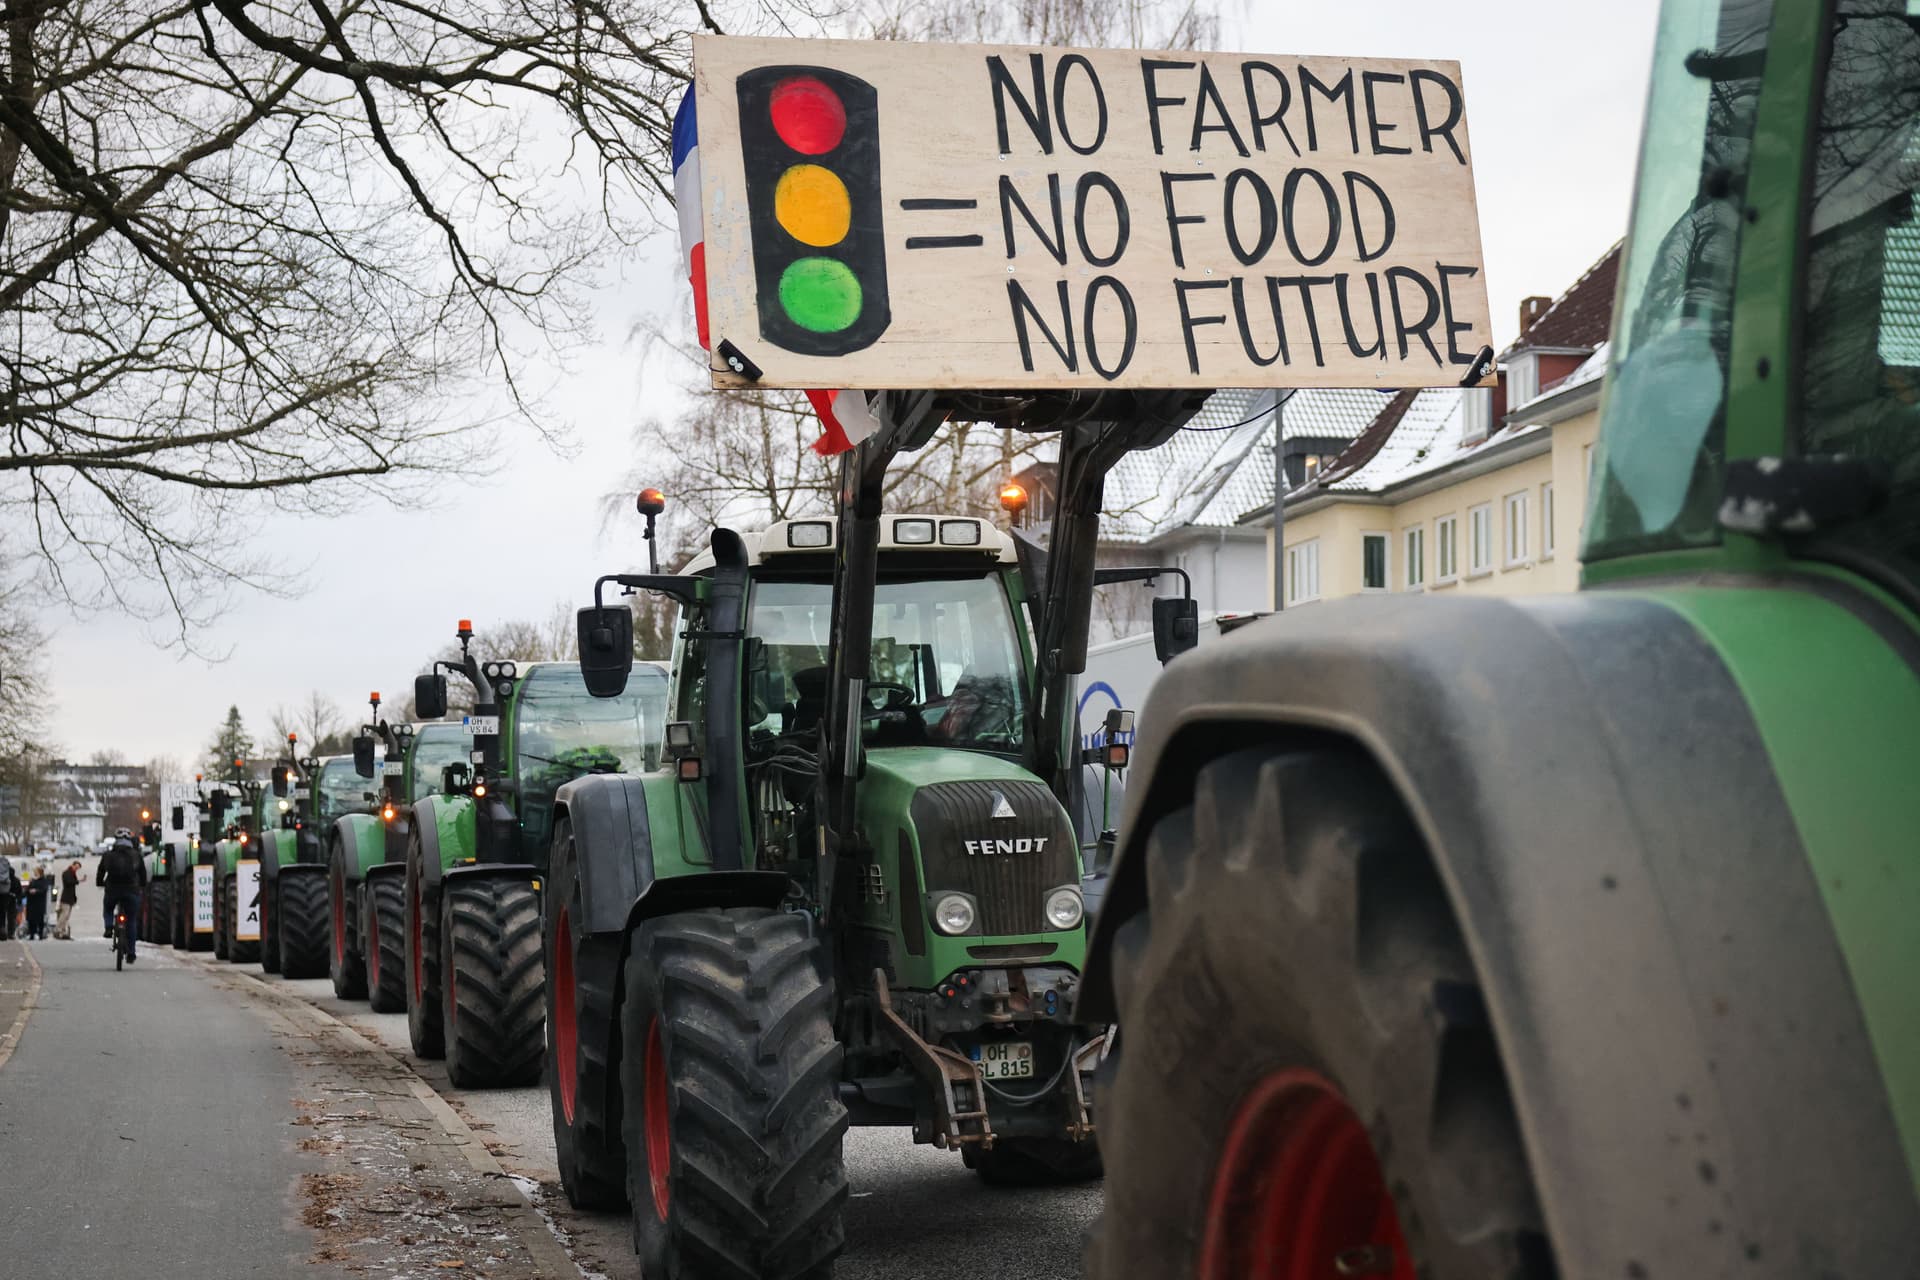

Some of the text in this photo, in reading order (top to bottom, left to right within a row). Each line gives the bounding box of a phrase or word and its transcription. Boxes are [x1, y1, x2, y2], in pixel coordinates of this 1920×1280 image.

[985, 52, 1467, 166] NO FARMER
[998, 170, 1130, 268] NO
[1159, 167, 1396, 270] FOOD
[1006, 260, 1480, 382] NO FUTURE
[471, 717, 483, 726] OH
[965, 838, 1049, 856] FENDT
[987, 1045, 1009, 1061] OH
[1000, 1060, 1031, 1077] 815
